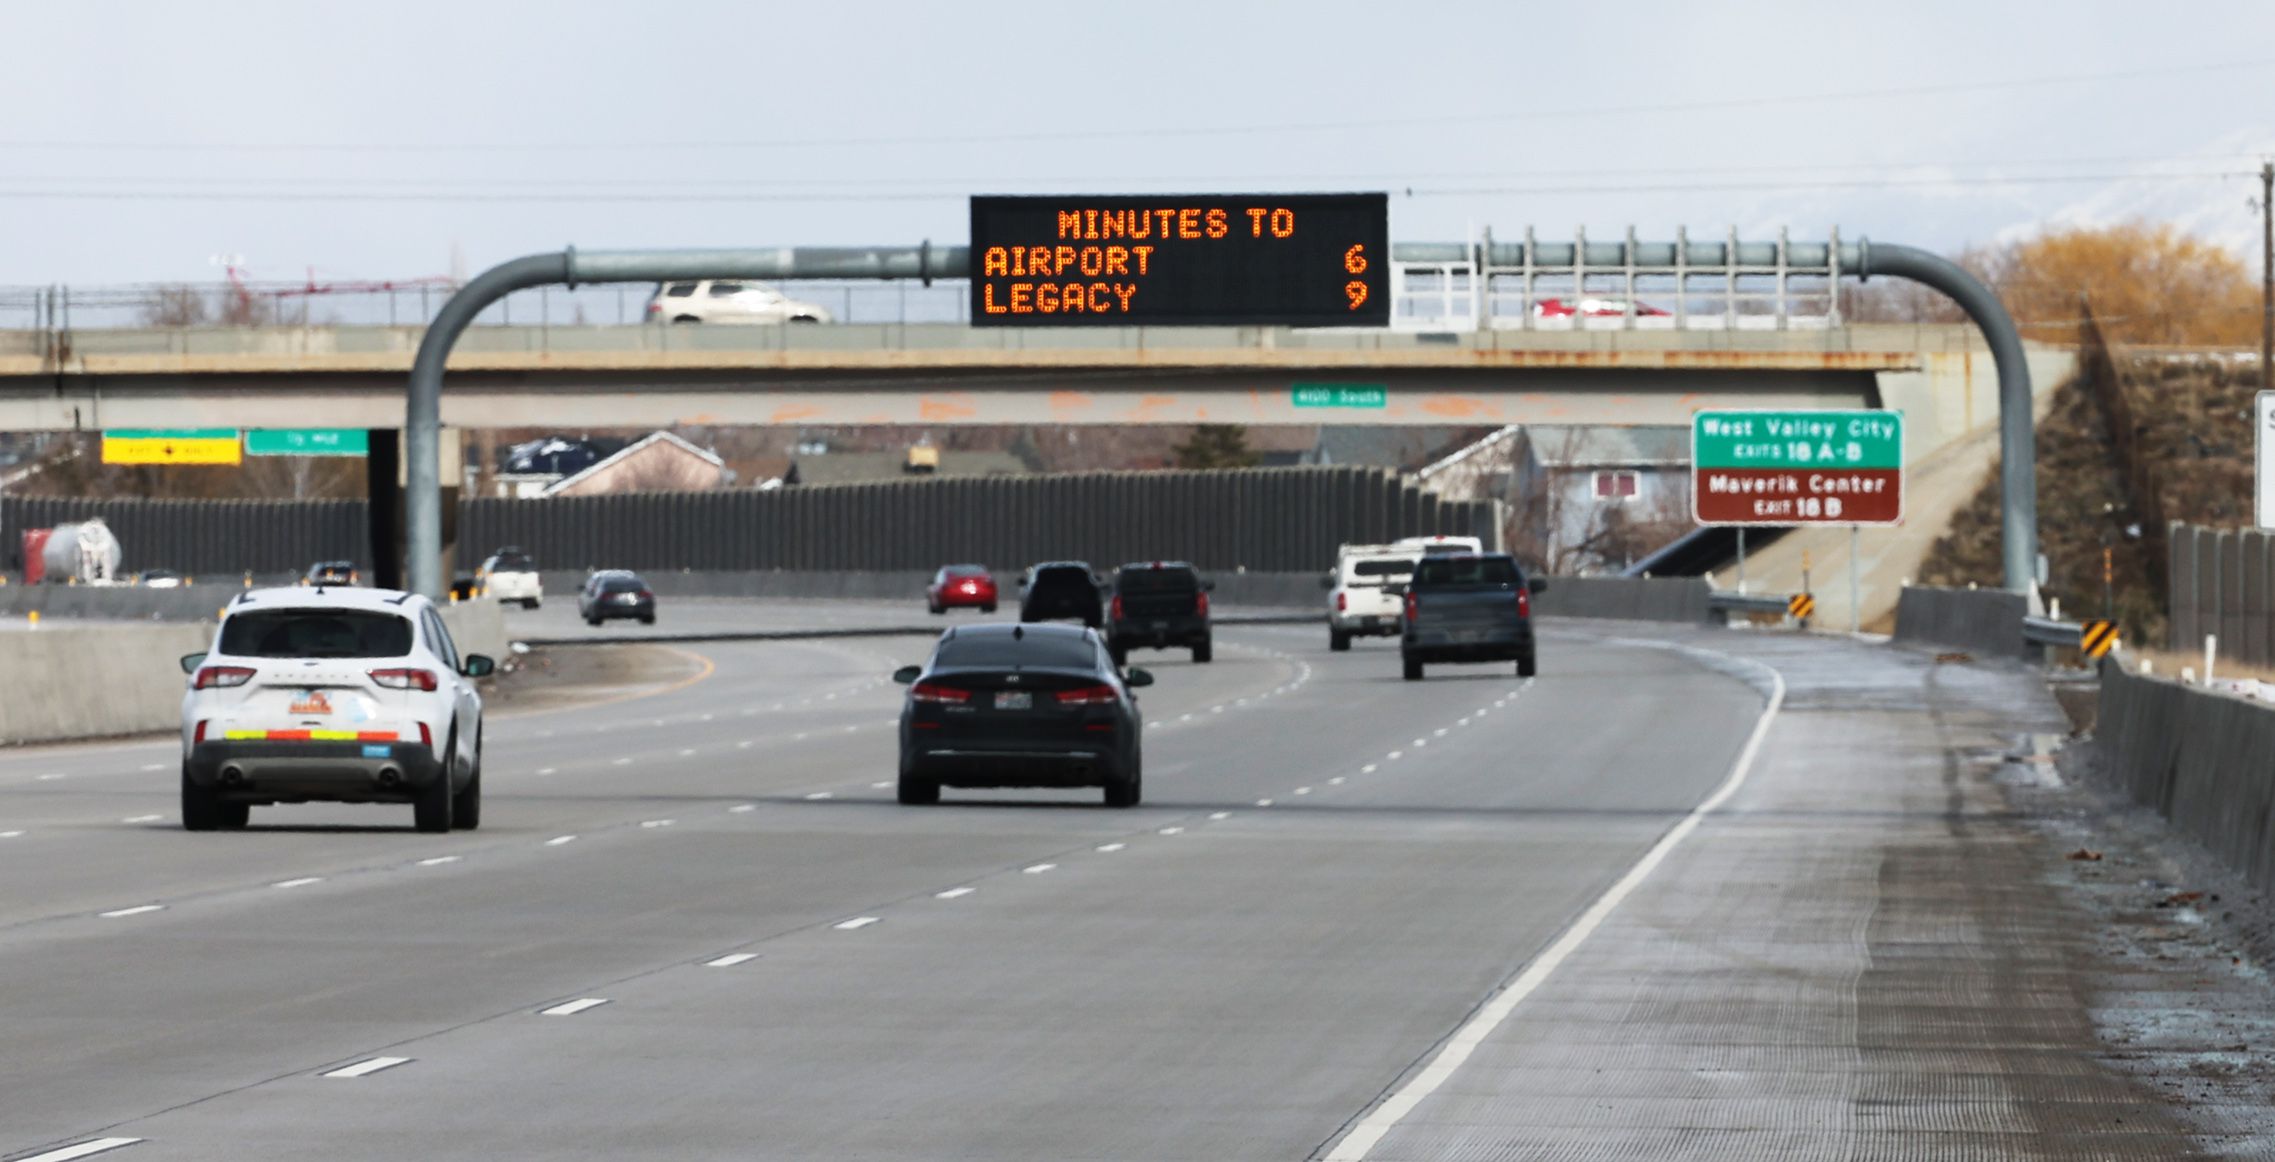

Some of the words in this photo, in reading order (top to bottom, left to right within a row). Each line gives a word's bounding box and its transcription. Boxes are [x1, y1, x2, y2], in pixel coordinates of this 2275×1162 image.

[1058, 208, 1229, 240] MINUTES
[1246, 208, 1295, 239] TO
[984, 245, 1154, 277] AIRPORT
[1344, 244, 1369, 275] 6
[984, 282, 1137, 314] LEGACY
[1344, 280, 1369, 311] 9
[1702, 418, 1753, 436] West
[1766, 418, 1837, 440] Valley
[1848, 418, 1896, 440] City
[1733, 444, 1782, 459] EXITS
[1786, 441, 1812, 462] 18
[1708, 473, 1799, 494] Maverik
[1808, 473, 1886, 494] Center
[1753, 499, 1792, 516] EXIT
[1795, 497, 1822, 518] 18
